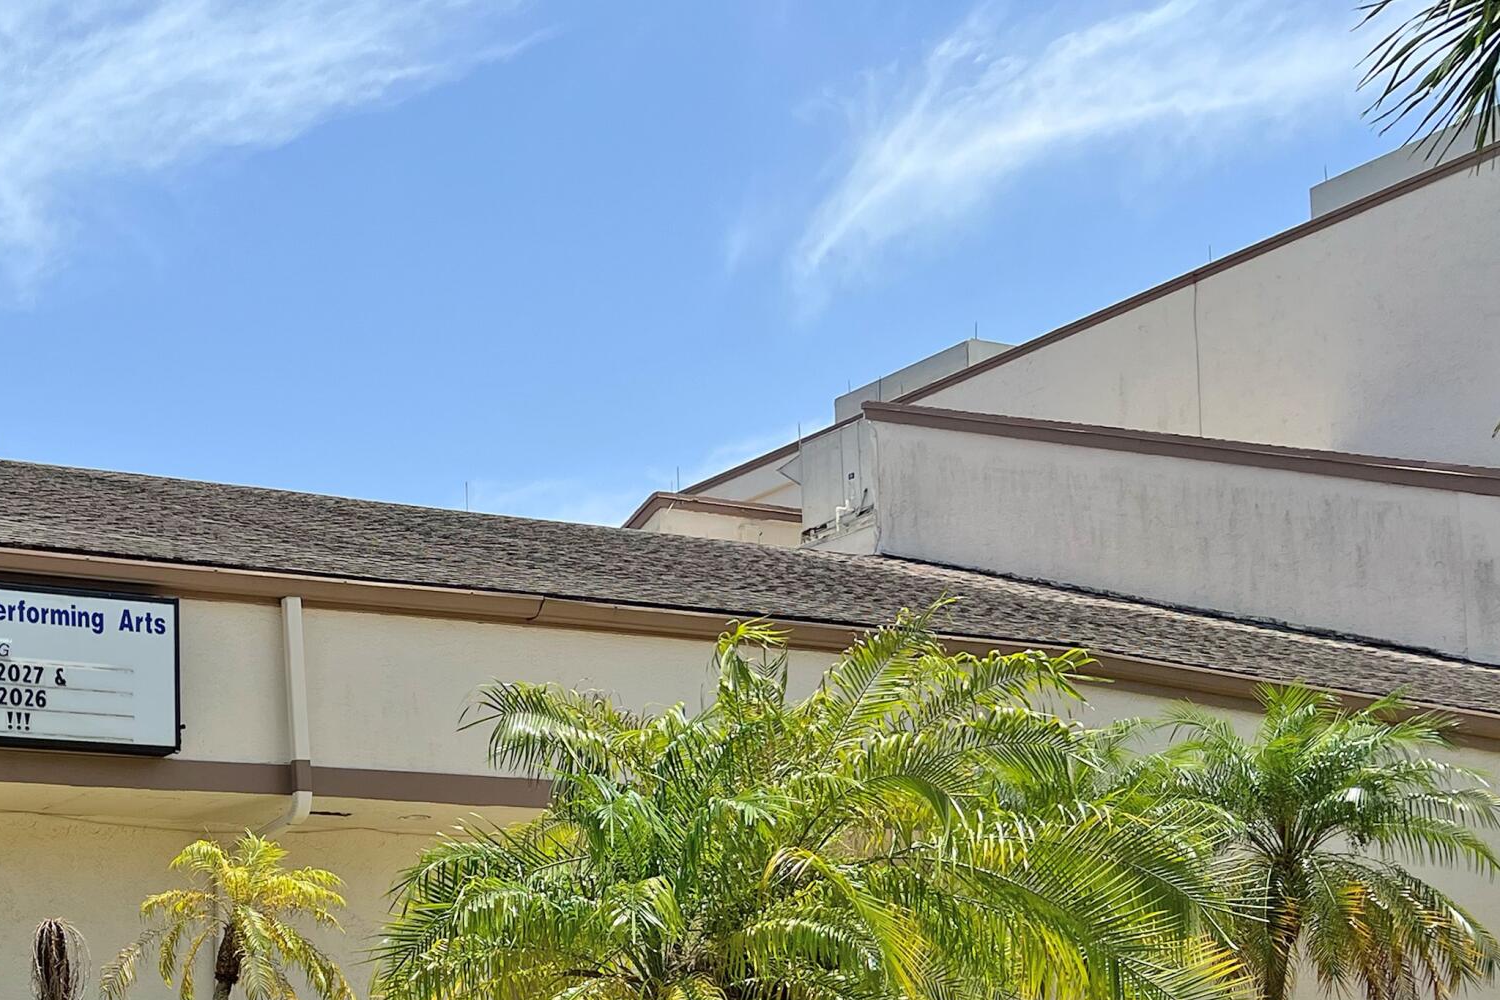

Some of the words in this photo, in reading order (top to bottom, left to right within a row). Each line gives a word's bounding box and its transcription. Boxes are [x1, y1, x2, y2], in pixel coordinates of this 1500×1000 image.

[119, 608, 166, 635] Arts
[54, 667, 67, 687] &
[7, 711, 31, 731] !!!
